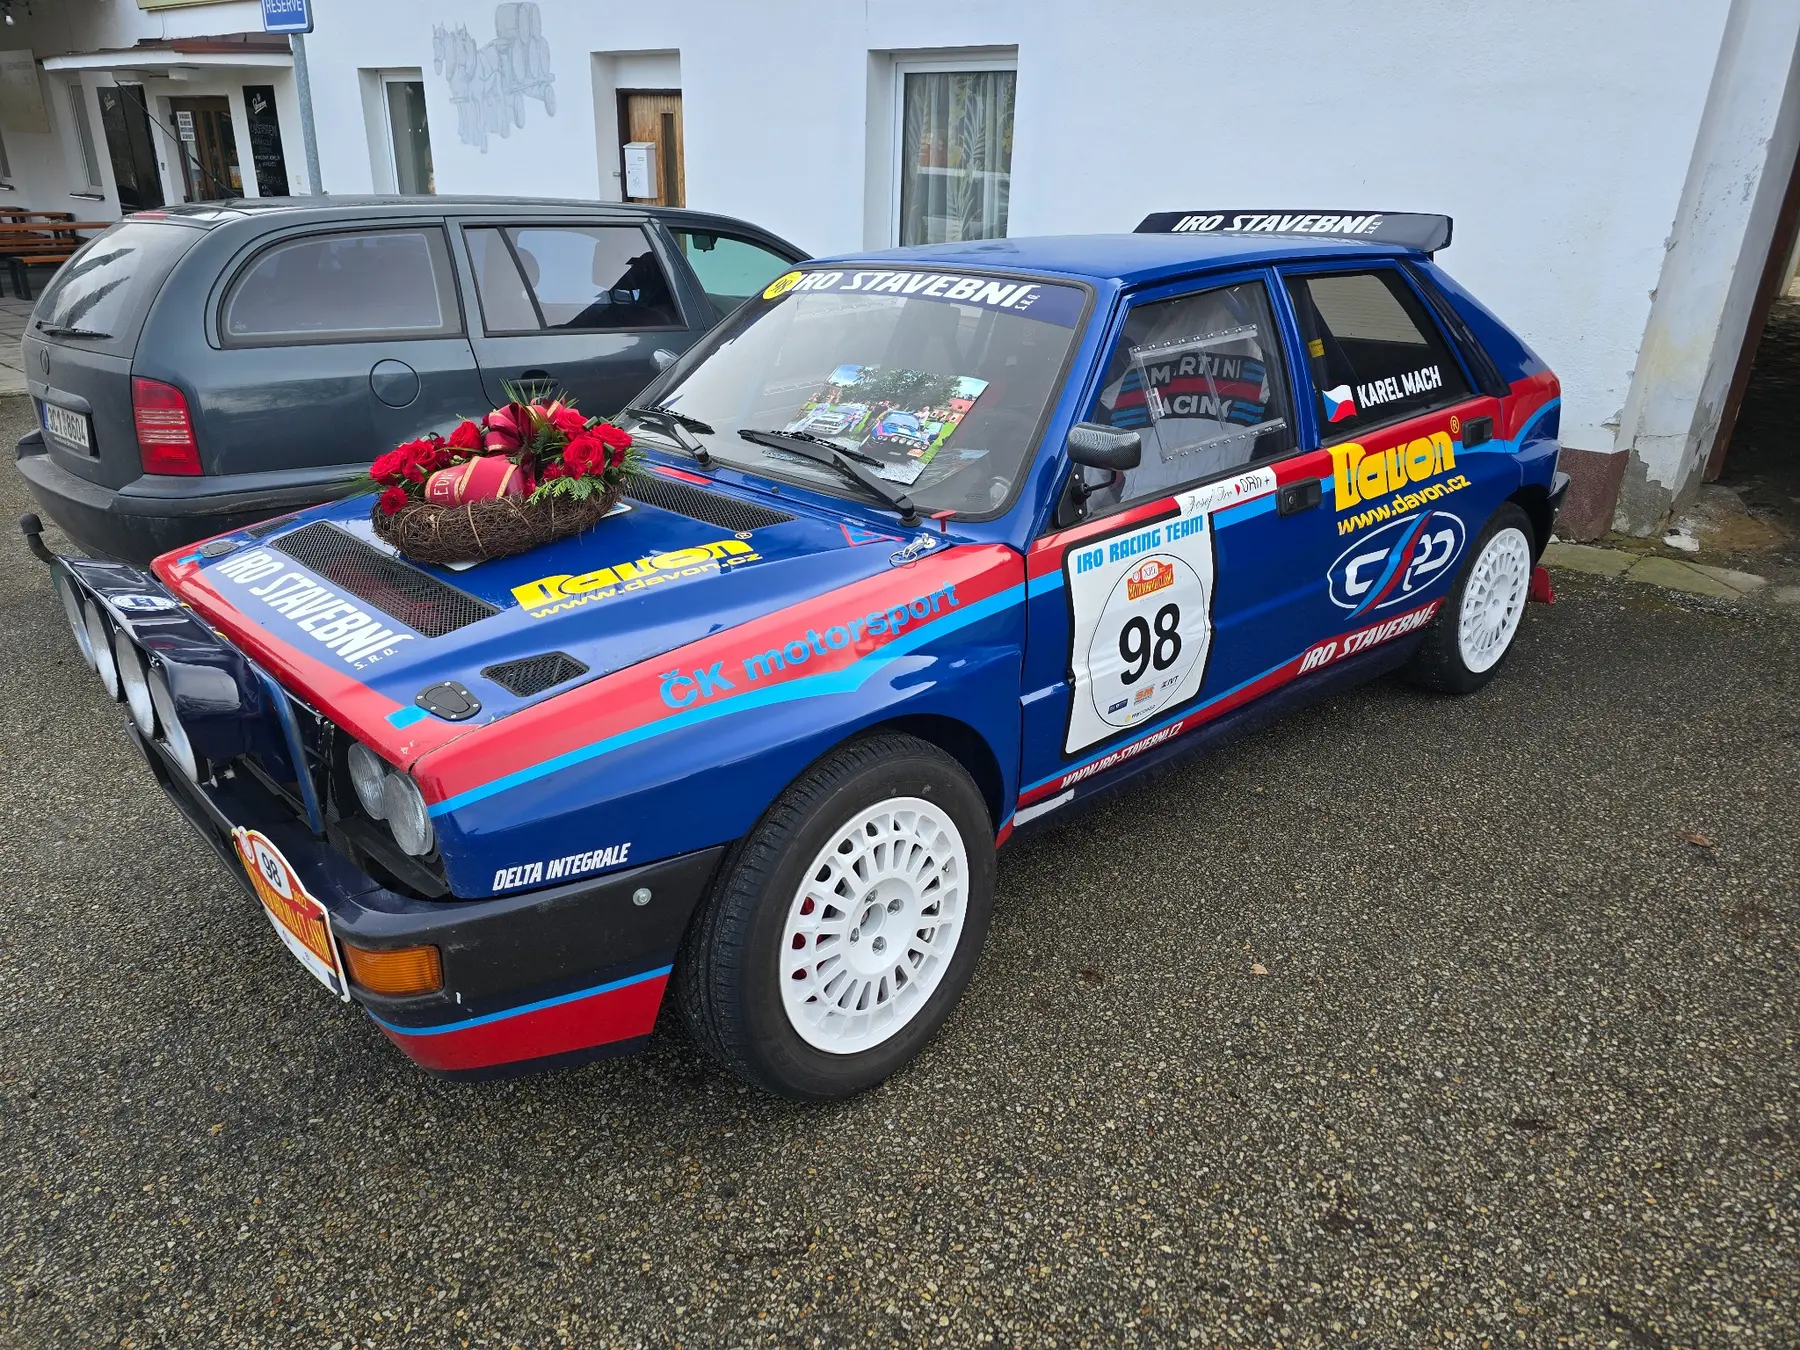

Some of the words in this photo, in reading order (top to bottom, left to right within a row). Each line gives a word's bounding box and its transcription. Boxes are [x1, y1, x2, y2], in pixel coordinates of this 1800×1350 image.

[1171, 215, 1225, 232] IRO
[1223, 213, 1384, 234] STAVEBNÍ
[840, 272, 1042, 308] STAVEBNÍ
[1356, 376, 1404, 409] KAREL
[1401, 365, 1442, 396] MACH
[1337, 474, 1472, 536] www.davon.cz
[216, 550, 285, 585] IRO
[1077, 547, 1104, 575] IRO
[1109, 527, 1161, 563] RACING
[1165, 514, 1204, 543] TEAM
[530, 552, 763, 619] www.davon.cz
[248, 571, 415, 664] STAVEBNÍ
[657, 660, 736, 708] ČK
[742, 580, 960, 681] motorsport
[1118, 602, 1182, 686] 98
[1297, 641, 1338, 676] IRO
[261, 852, 282, 888] 98
[492, 861, 543, 891] DELTA
[546, 842, 632, 881] INTEGRALE
